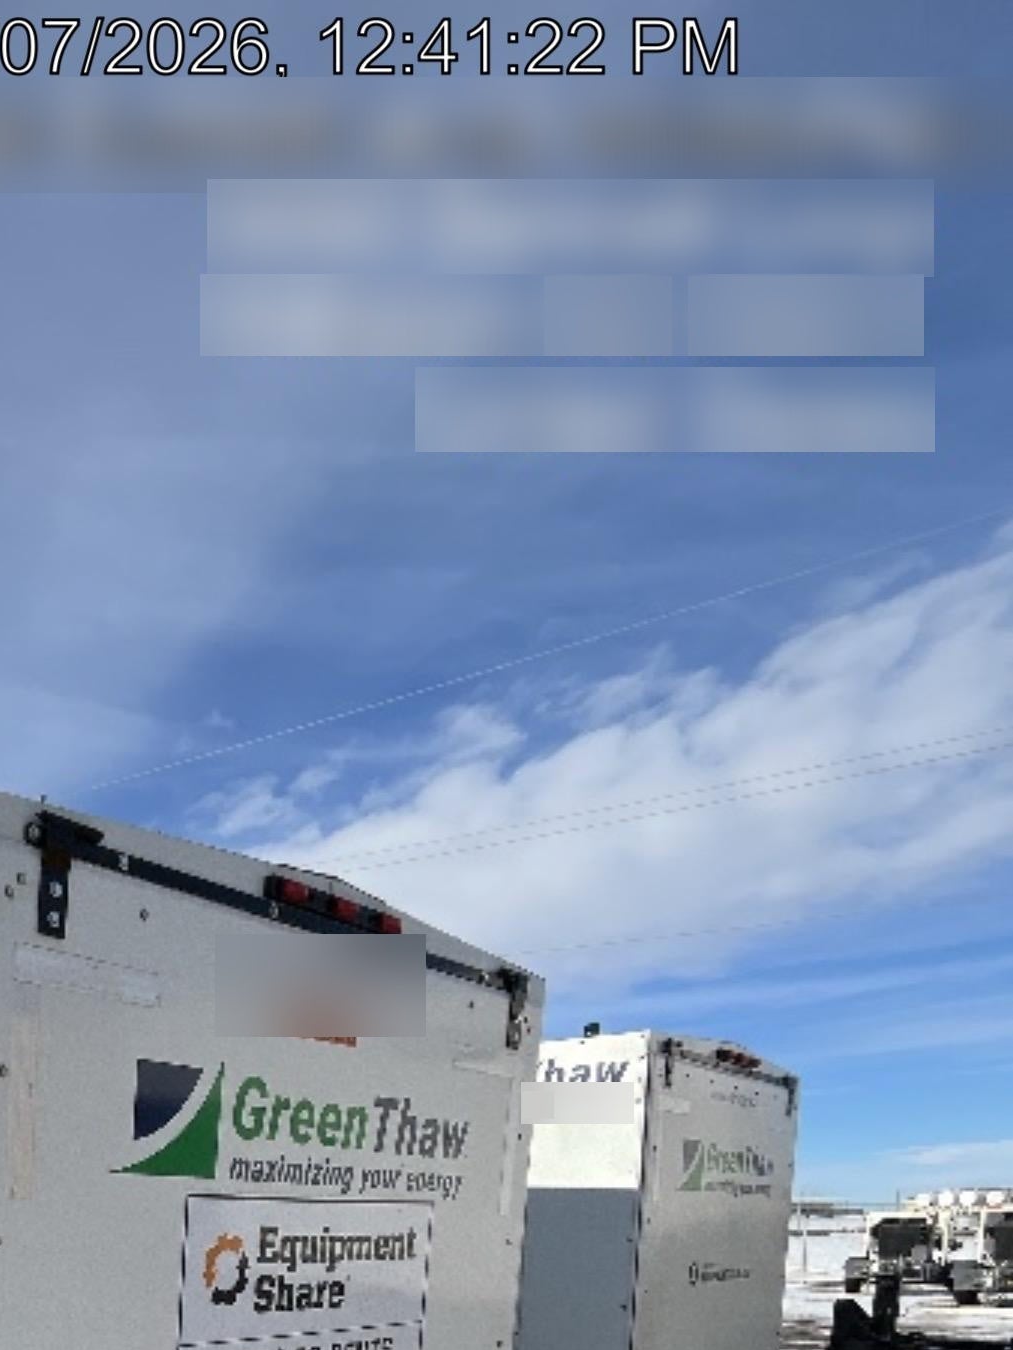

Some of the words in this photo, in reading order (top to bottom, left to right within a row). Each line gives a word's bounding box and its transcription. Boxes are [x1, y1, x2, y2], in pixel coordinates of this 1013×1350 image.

[229, 1155, 354, 1195] maximizing
[358, 1165, 403, 1194] your
[406, 1172, 463, 1201] energy
[256, 1226, 418, 1273] Equipment
[253, 1274, 346, 1314] Share
